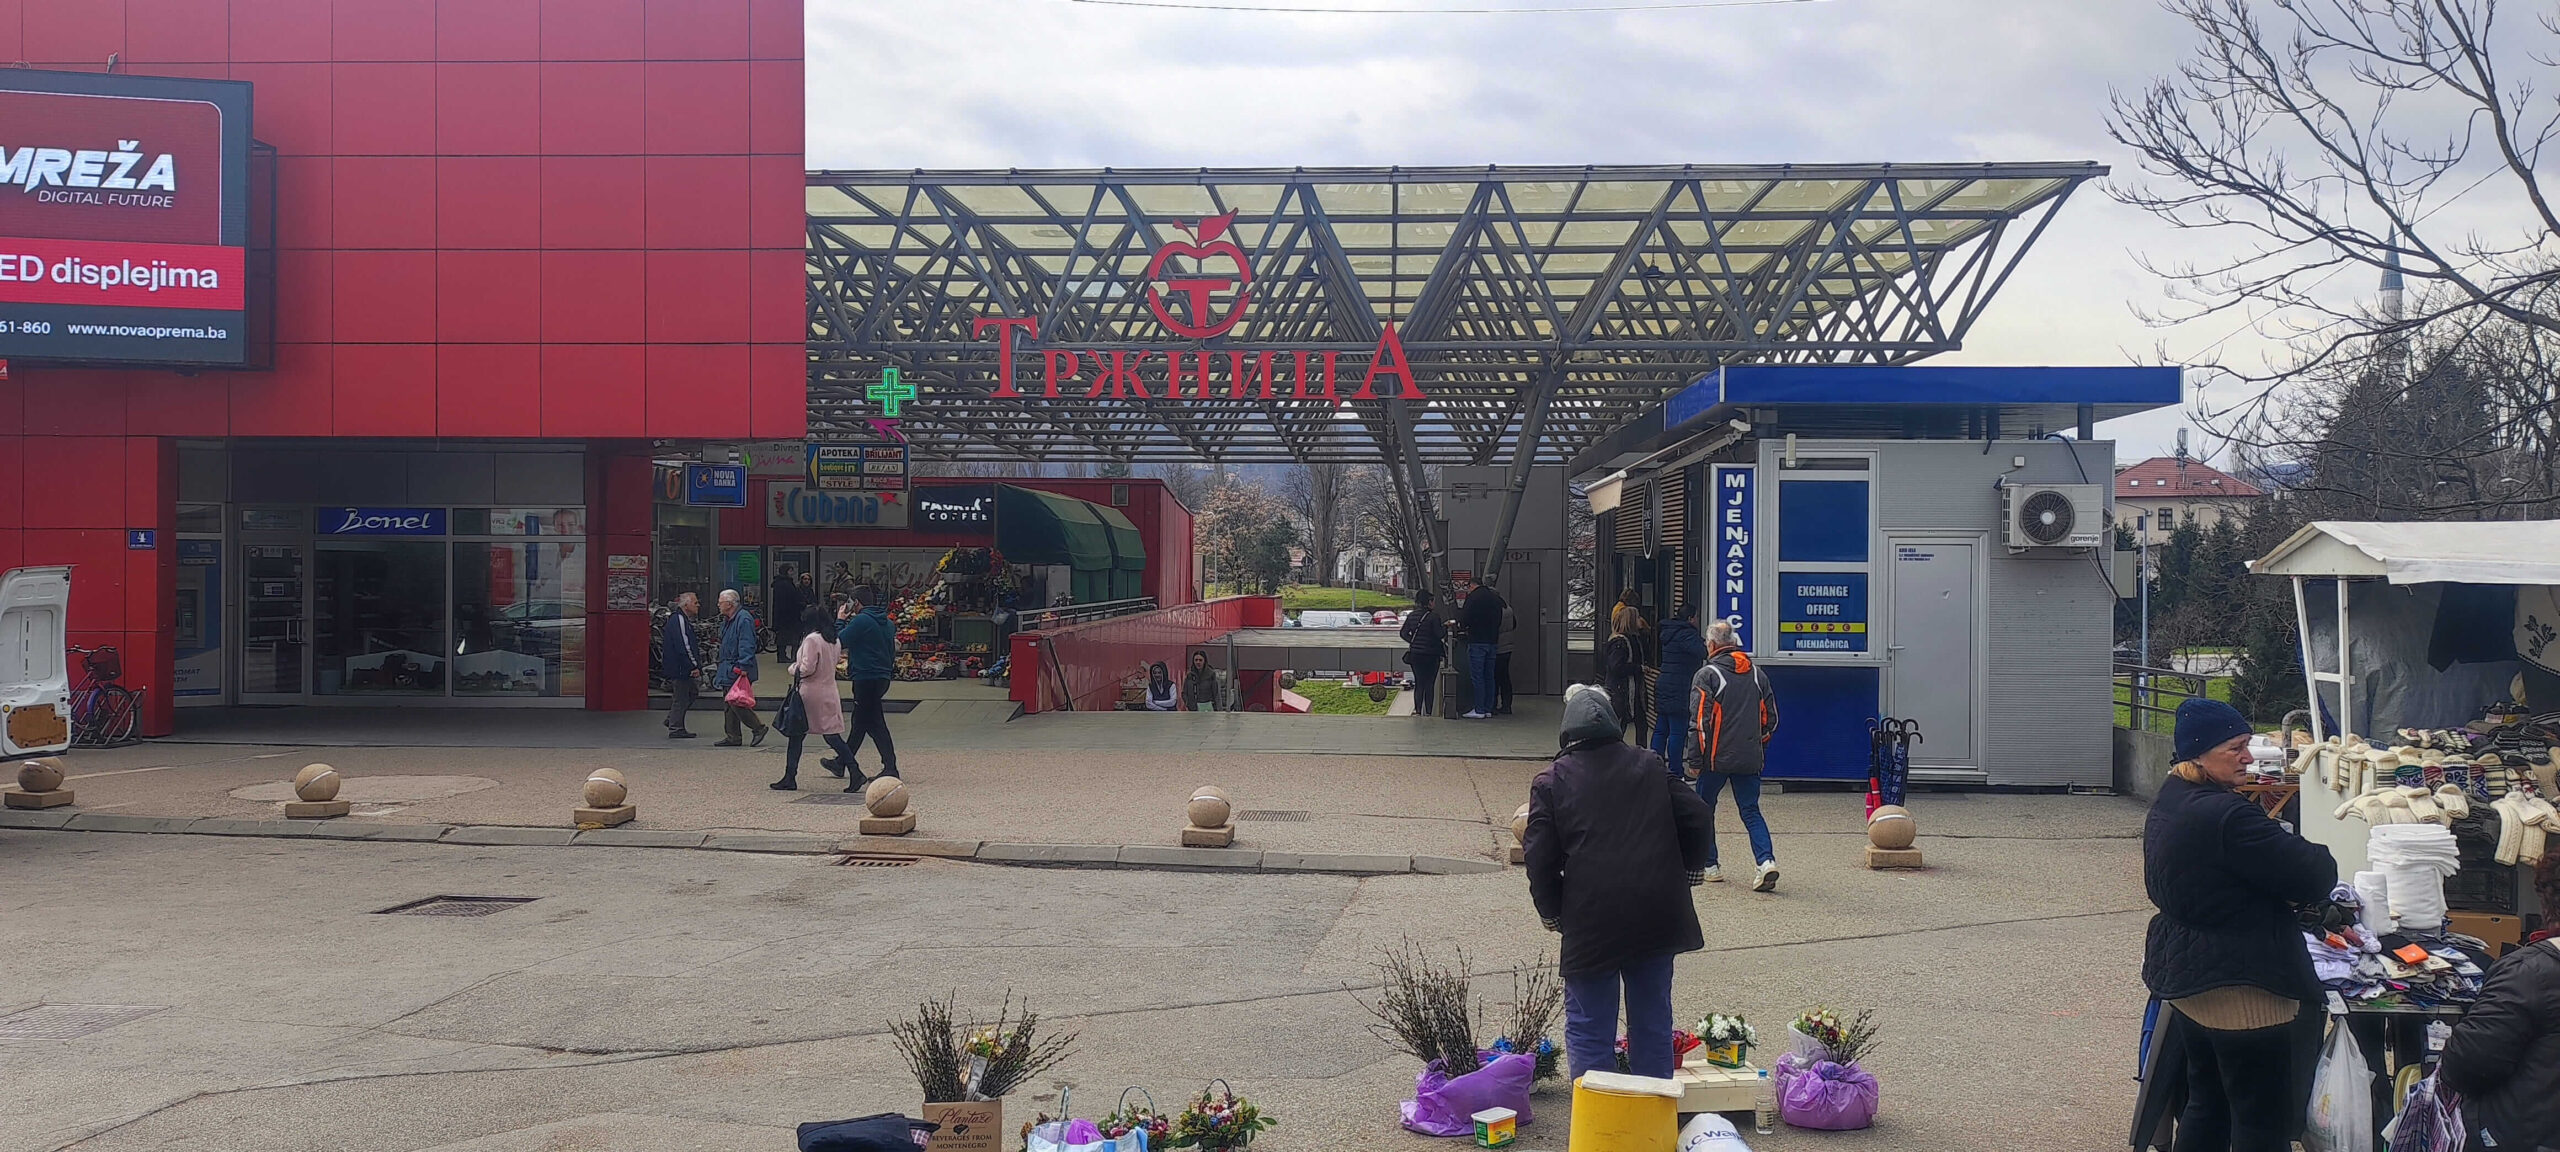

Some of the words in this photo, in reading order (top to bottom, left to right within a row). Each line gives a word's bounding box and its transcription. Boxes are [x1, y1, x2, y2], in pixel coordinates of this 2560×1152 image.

[38, 189, 103, 205] DIGITAL
[108, 193, 174, 208] FUTURE
[51, 257, 219, 292] displejima
[68, 322, 227, 339] www.novaoprema.ba
[821, 449, 859, 457] APOTEKA
[865, 450, 903, 459] BRILIJANT
[714, 470, 735, 479] NOVA
[714, 479, 736, 487] BANKA
[787, 487, 879, 523] Cubana
[333, 508, 431, 534] Bonel
[136, 531, 147, 543] 4
[2070, 535, 2099, 543] gorenje
[1797, 585, 1849, 597] EXCHANGE
[1806, 603, 1840, 615] OFFICE
[1796, 638, 1850, 649] MJENJAČNICA
[932, 1134, 970, 1142] BEVERAGES
[936, 1142, 988, 1150] MONTENEGRO
